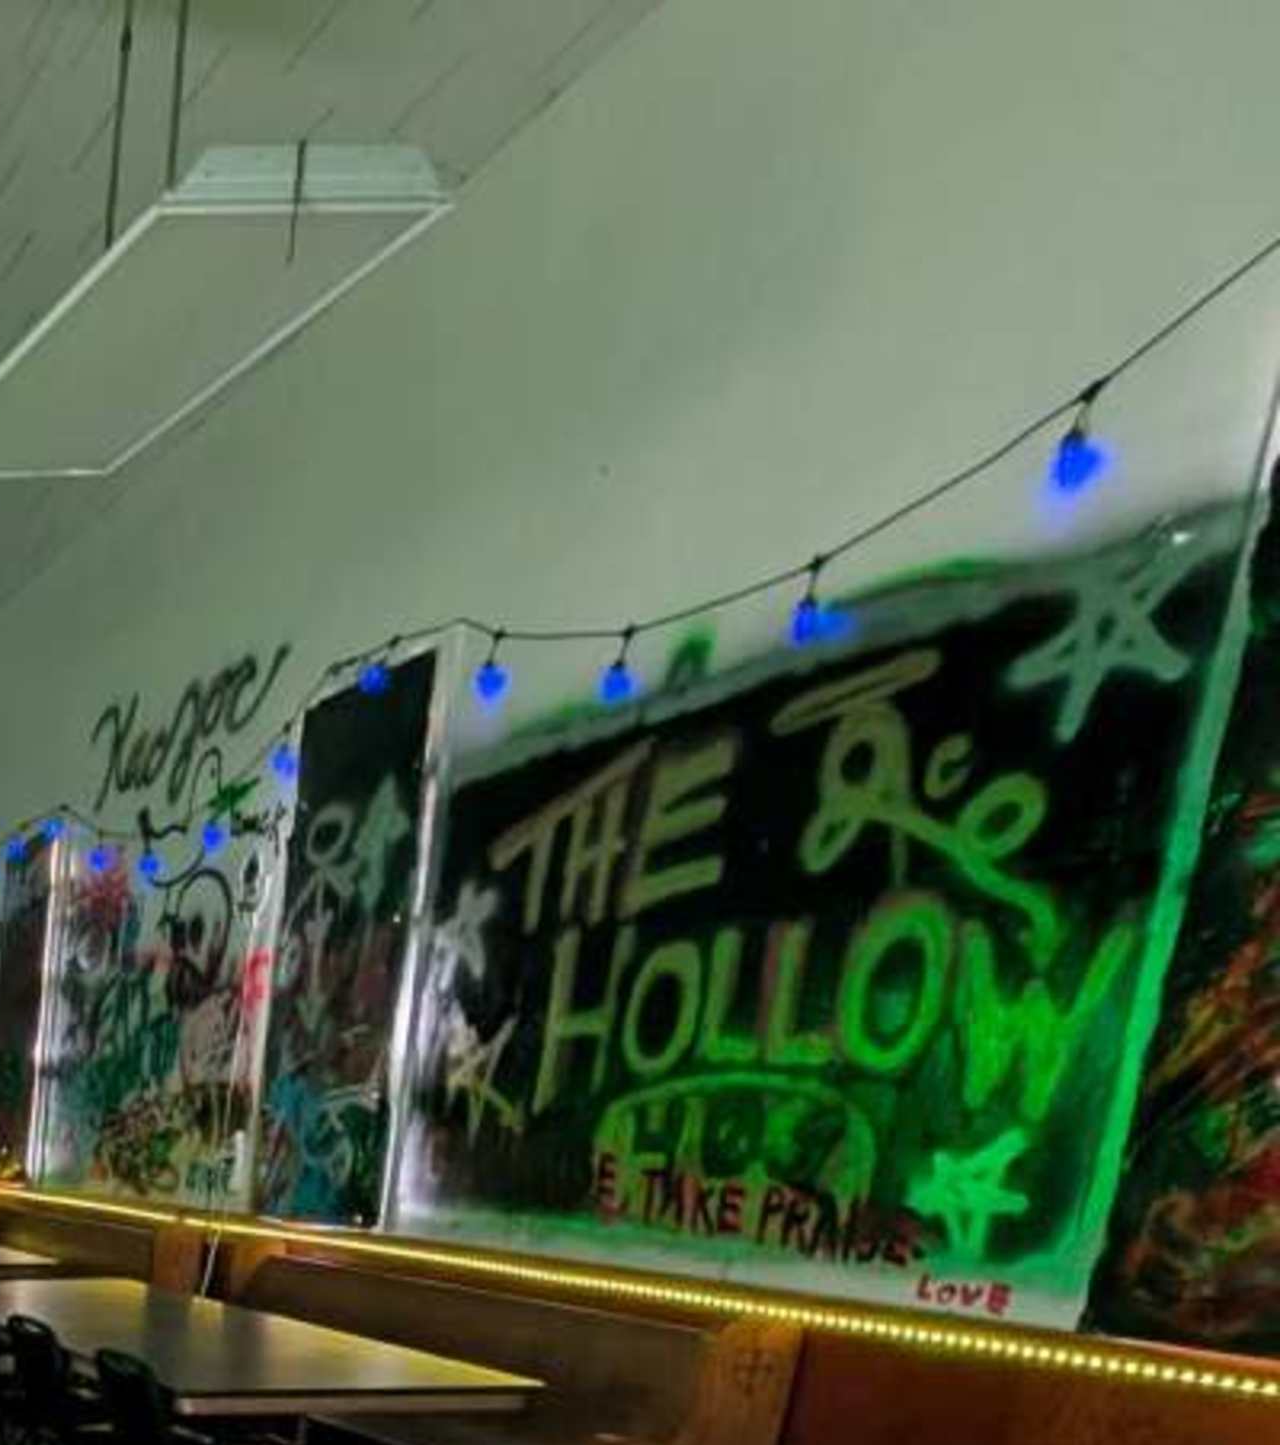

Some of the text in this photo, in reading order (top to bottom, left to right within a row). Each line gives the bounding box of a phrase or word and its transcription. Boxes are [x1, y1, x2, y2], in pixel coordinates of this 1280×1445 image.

[486, 728, 744, 934] THE
[533, 889, 1138, 1118] HOLLOW
[917, 1273, 1013, 1317] LOVE
